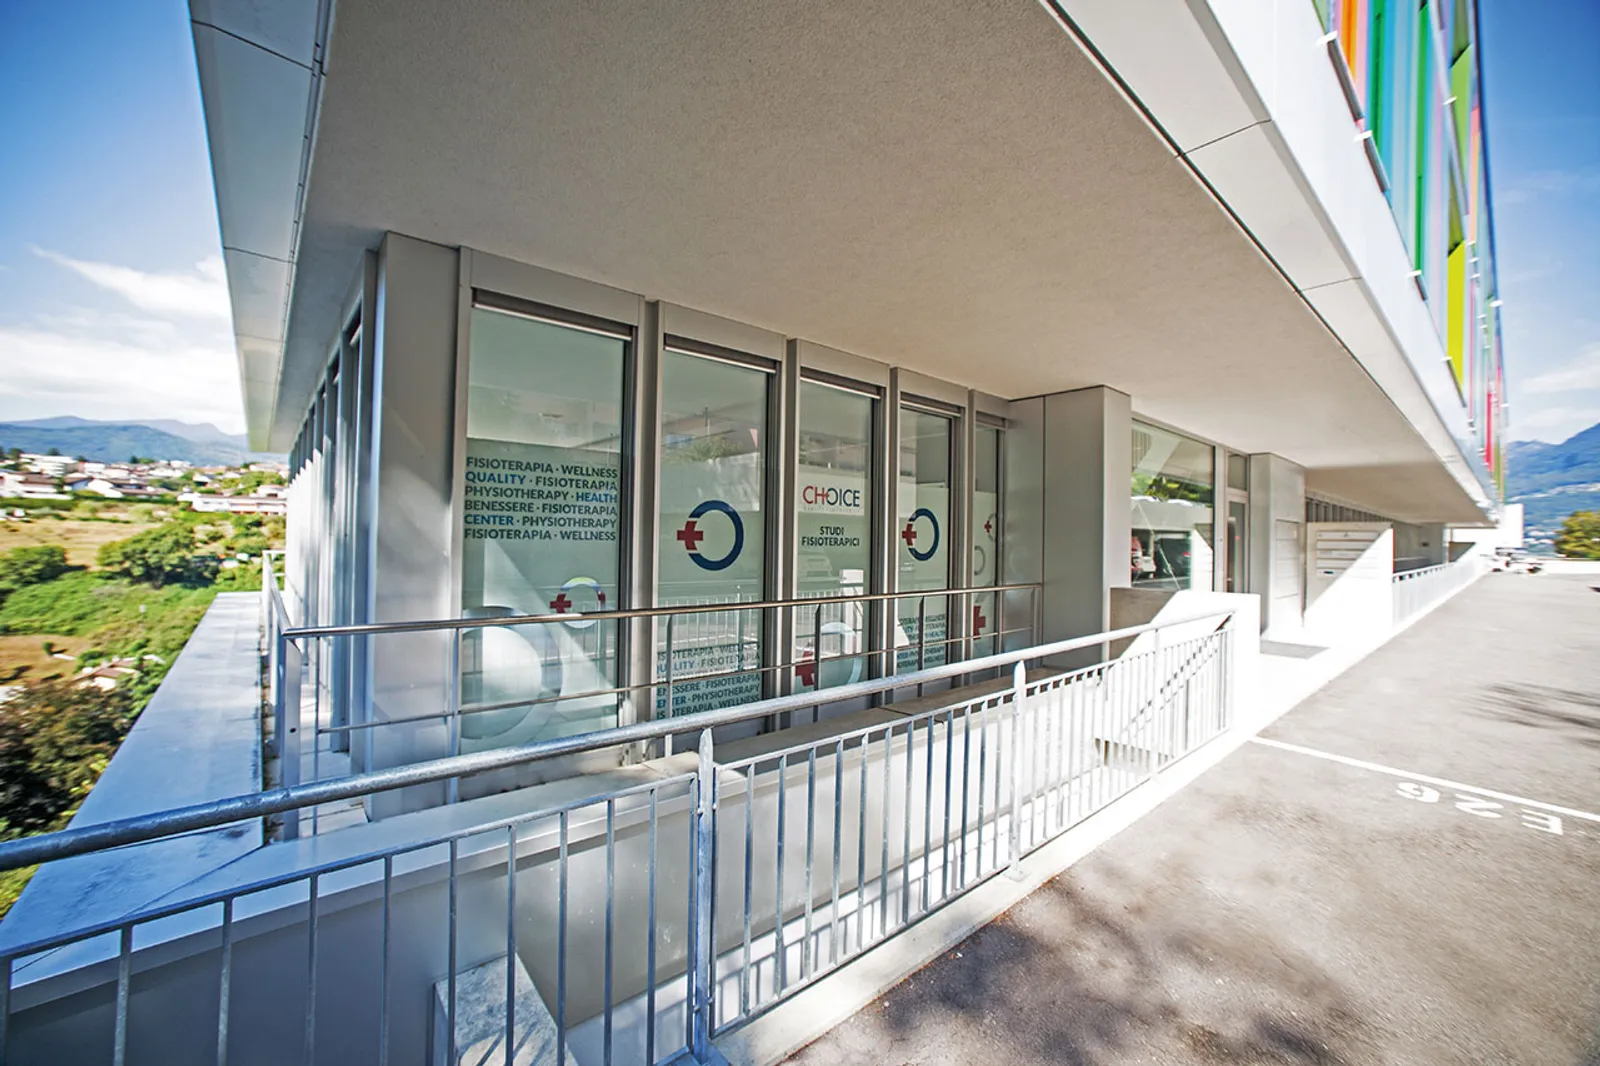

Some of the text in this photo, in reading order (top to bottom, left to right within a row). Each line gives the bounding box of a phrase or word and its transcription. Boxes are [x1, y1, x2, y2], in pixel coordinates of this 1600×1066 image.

[466, 456, 618, 479] FISIOTERAPIA WELLNESS
[465, 471, 618, 491] QUALITY FISIOTERAPIA
[465, 485, 618, 503] PHYSIOTHERAPY HEALTH
[802, 485, 861, 507] CHOICE
[465, 500, 618, 517] BENESSERE FISIOTERAPIA
[464, 514, 617, 529] CENTER PHYSIOTHERAPY
[464, 528, 616, 541] FISIOTERAPIA WELLNESS
[819, 525, 845, 536] STUDI
[801, 536, 861, 547] FISIOTERAPICI
[706, 673, 760, 689] FISIOTERAPIA
[692, 682, 760, 702] PHYSIOTHERAPY
